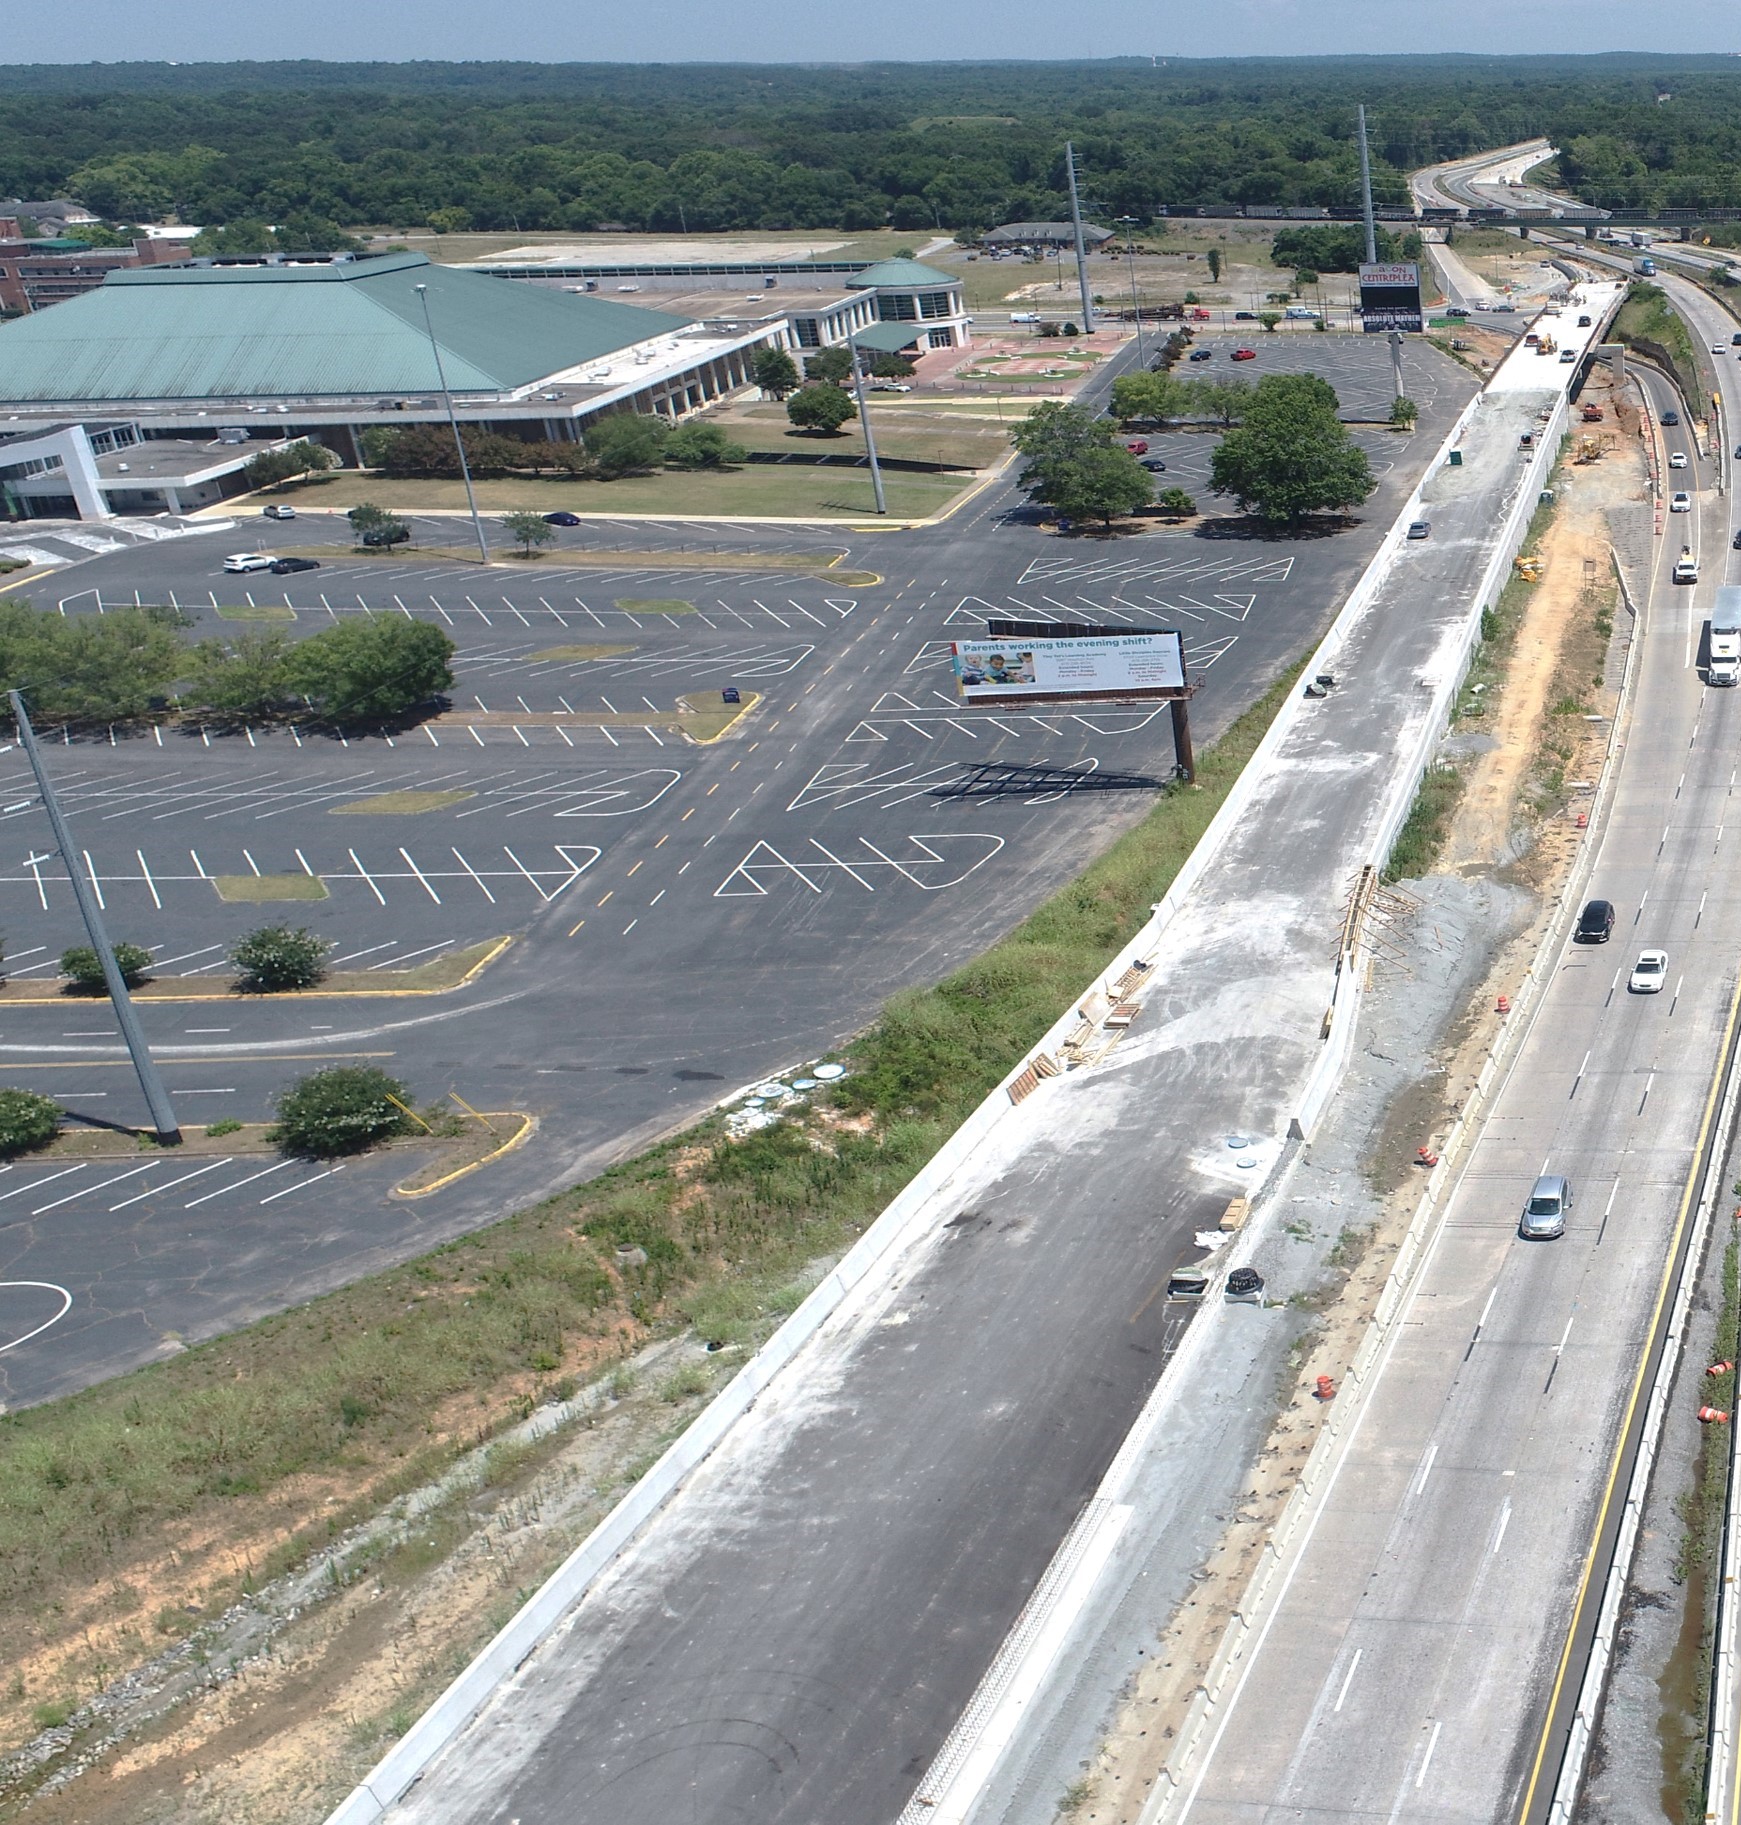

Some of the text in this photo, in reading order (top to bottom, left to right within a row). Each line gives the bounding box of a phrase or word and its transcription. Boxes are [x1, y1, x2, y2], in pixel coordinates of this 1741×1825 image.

[1362, 274, 1415, 282] CENTREPLEX
[964, 644, 1006, 652] Parents
[1008, 642, 1053, 650] working
[1077, 639, 1119, 647] evening
[1122, 637, 1153, 646] shift?
